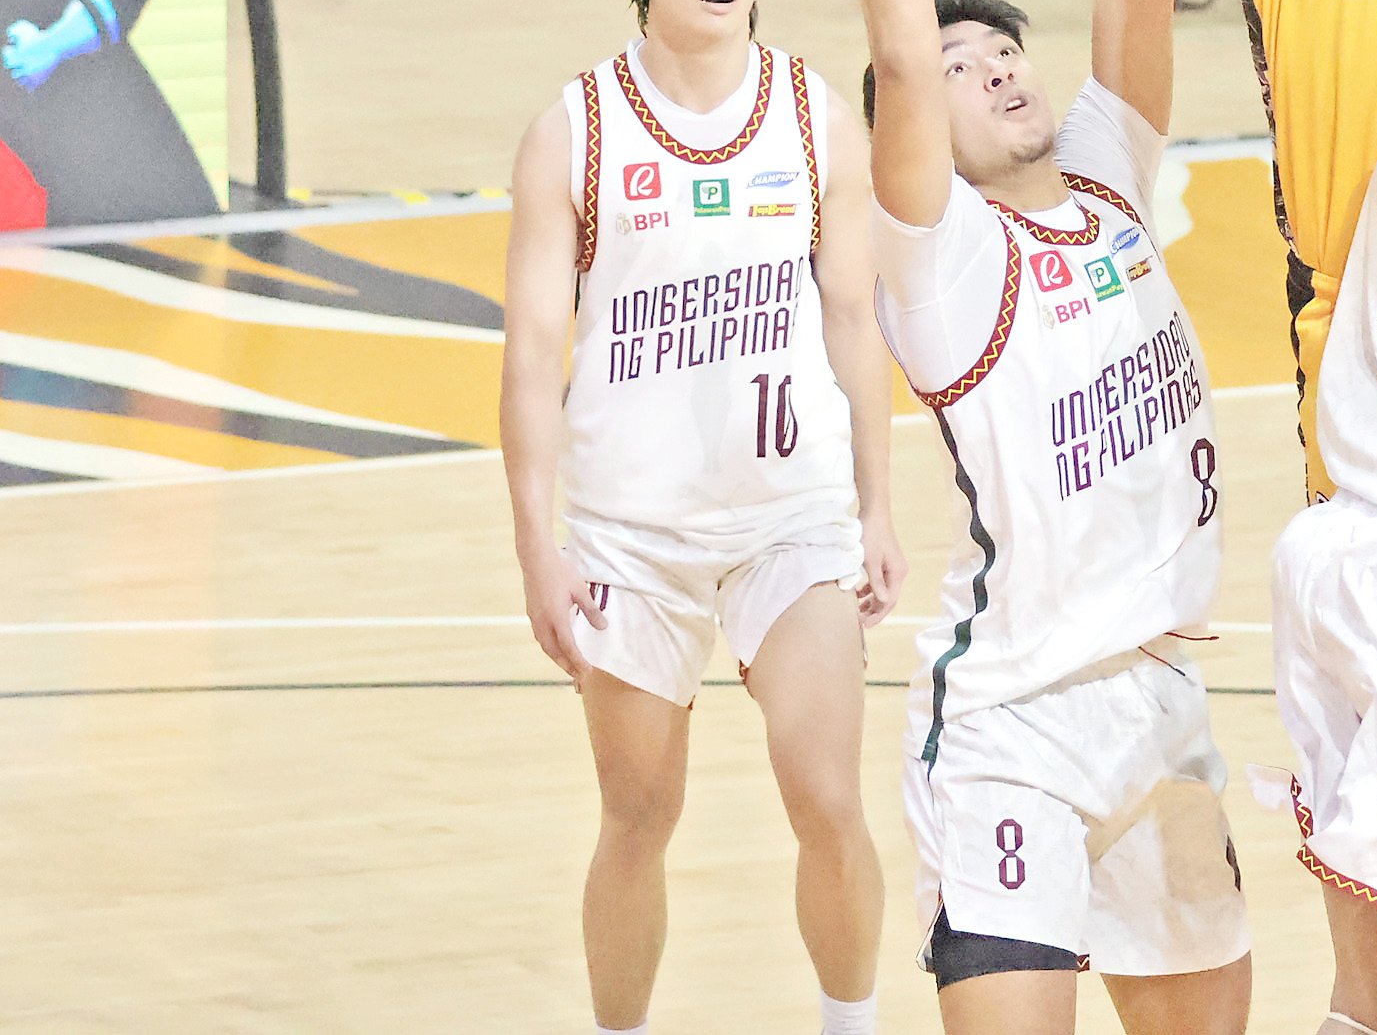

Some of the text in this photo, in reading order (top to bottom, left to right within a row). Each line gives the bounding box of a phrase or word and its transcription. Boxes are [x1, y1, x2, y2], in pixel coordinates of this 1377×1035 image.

[634, 211, 669, 231] BPI
[608, 303, 798, 383] NG PILIPINA
[1055, 297, 1091, 323] BPI
[750, 373, 798, 458] 10
[1056, 441, 1092, 501] NG
[1190, 437, 1218, 528] 8
[996, 818, 1026, 890] 8
